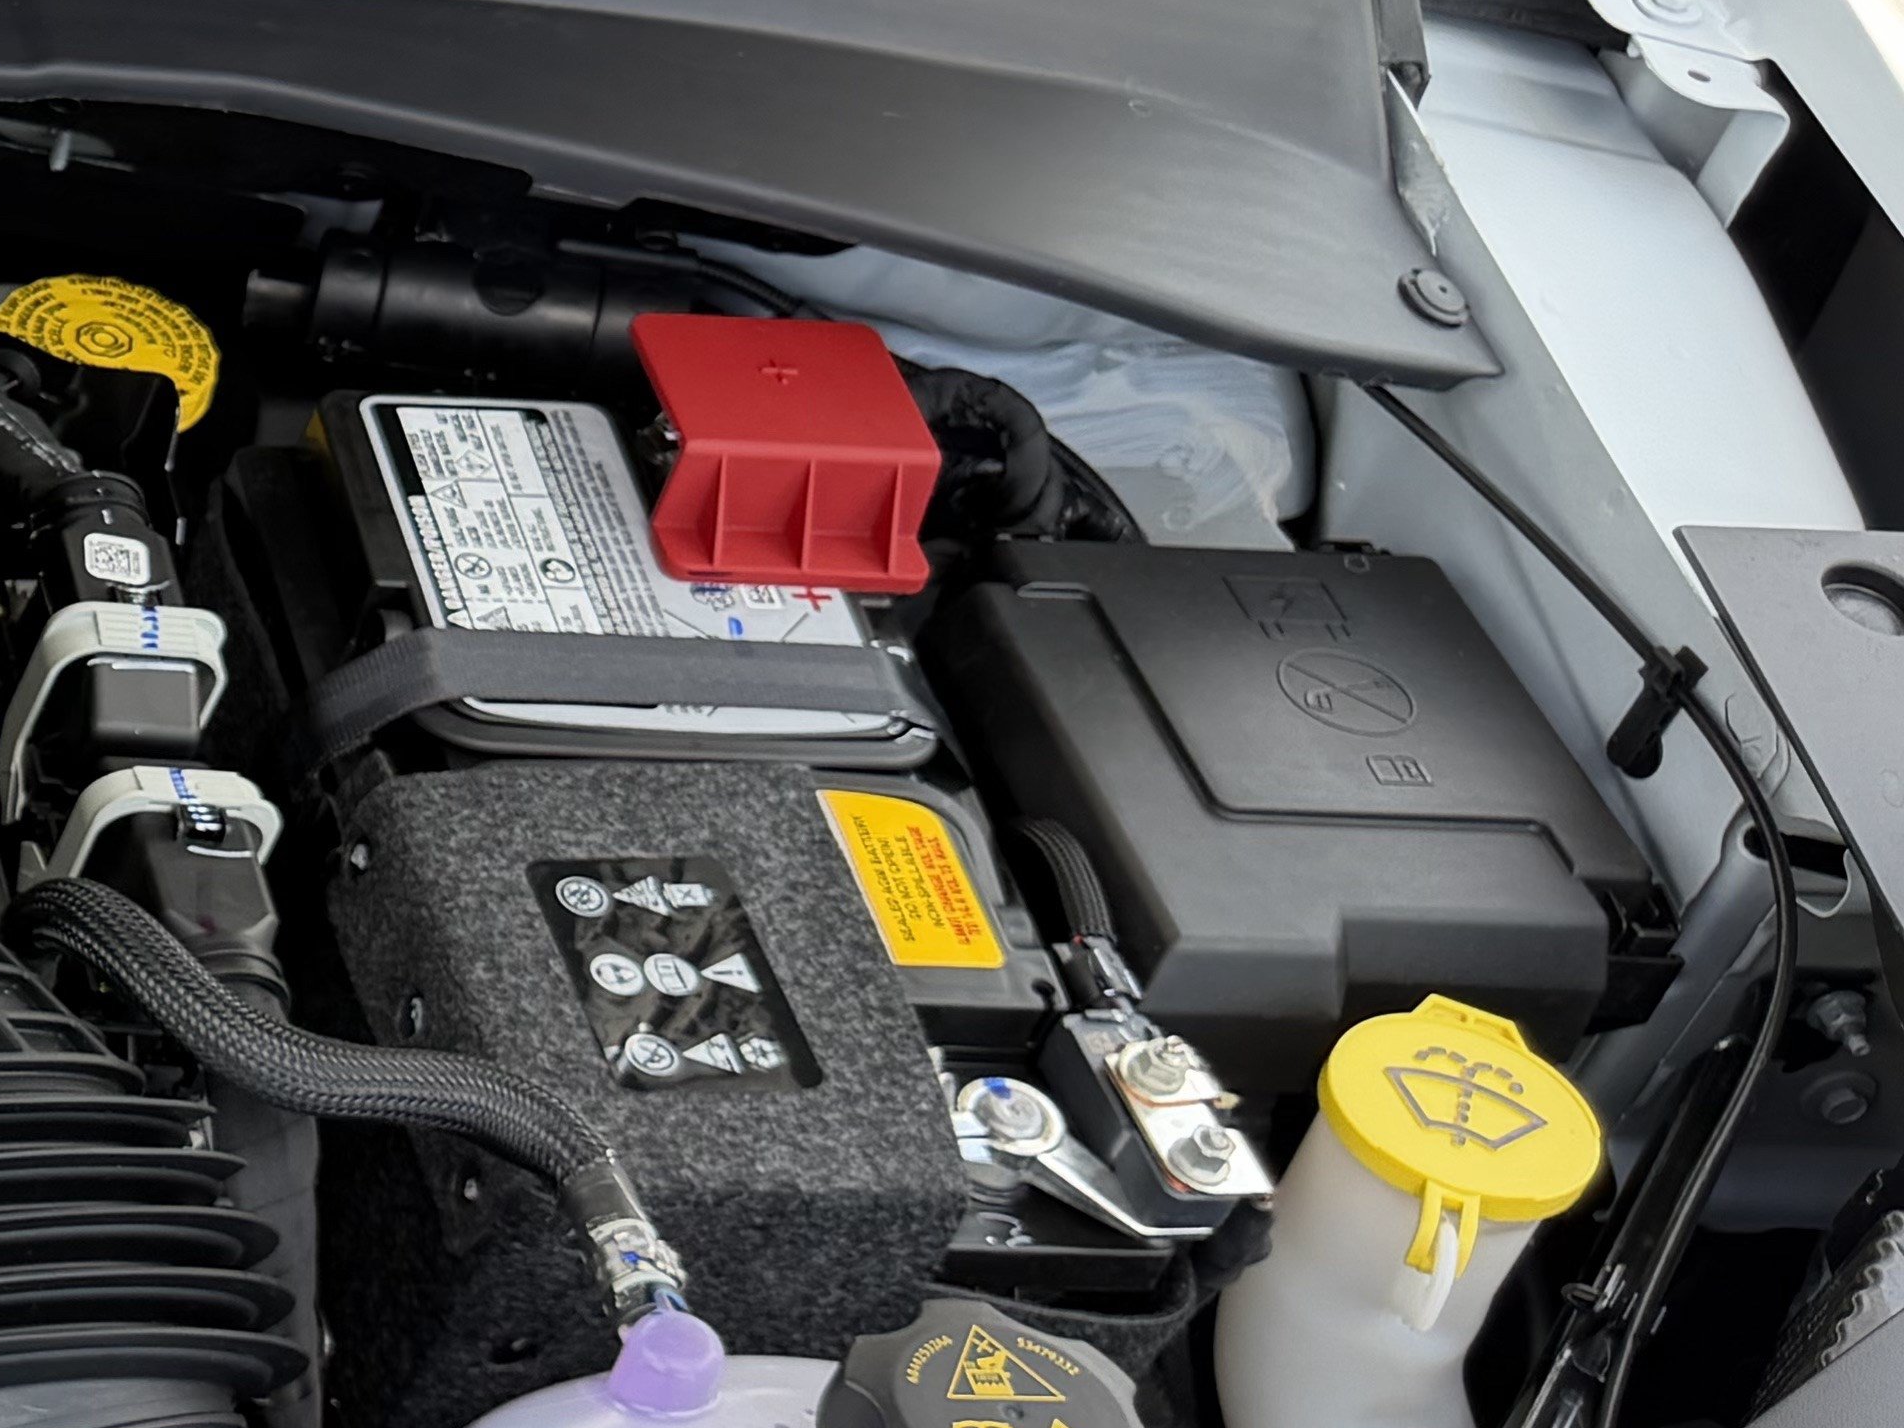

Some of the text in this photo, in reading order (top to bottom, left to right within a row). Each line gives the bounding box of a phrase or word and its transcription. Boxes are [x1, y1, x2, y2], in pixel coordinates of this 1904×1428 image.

[849, 814, 882, 864] BATTERY
[892, 876, 913, 898] NOT
[885, 897, 915, 941] SEALED
